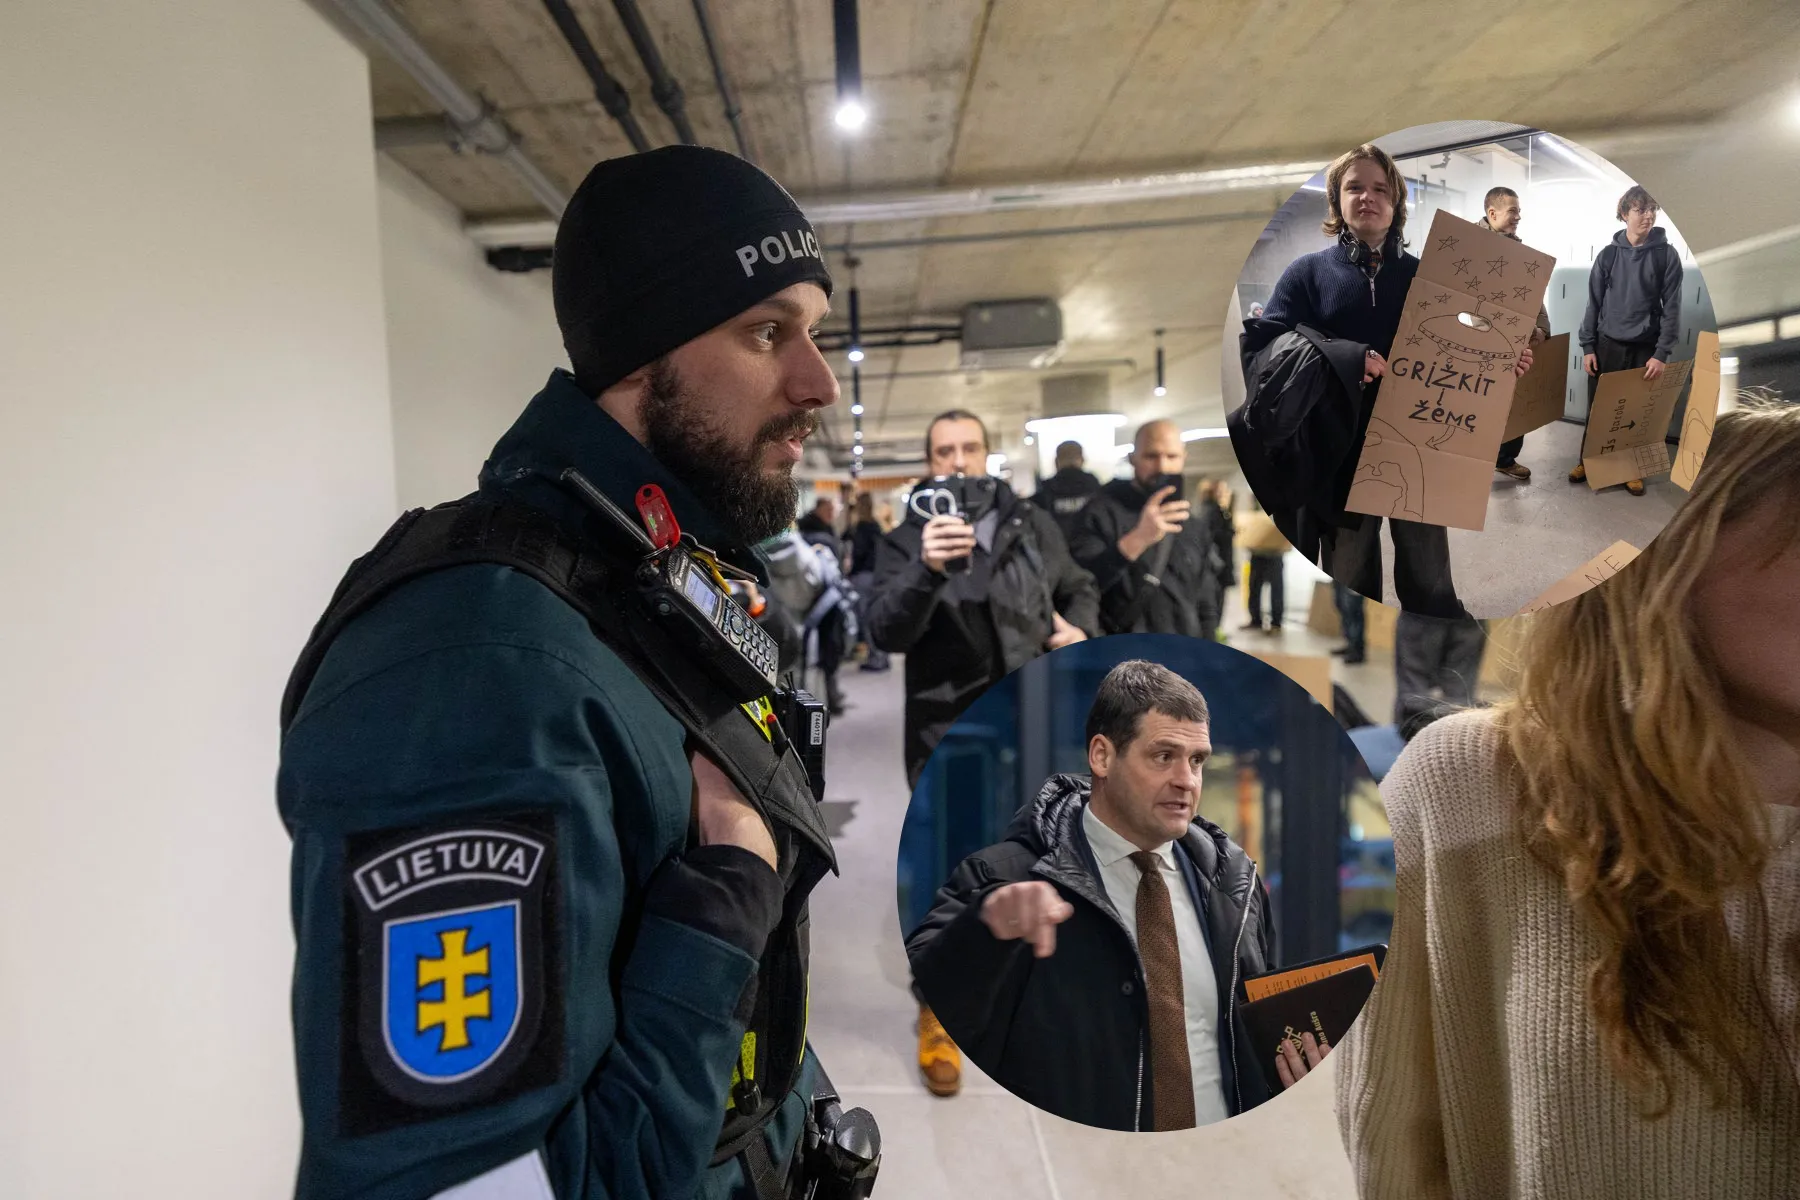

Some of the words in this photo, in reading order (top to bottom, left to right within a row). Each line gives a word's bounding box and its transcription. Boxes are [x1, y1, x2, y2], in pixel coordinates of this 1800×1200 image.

[736, 229, 824, 277] POLIC
[1392, 357, 1495, 396] GRĮŽKIT
[371, 841, 525, 896] LIETUVA
